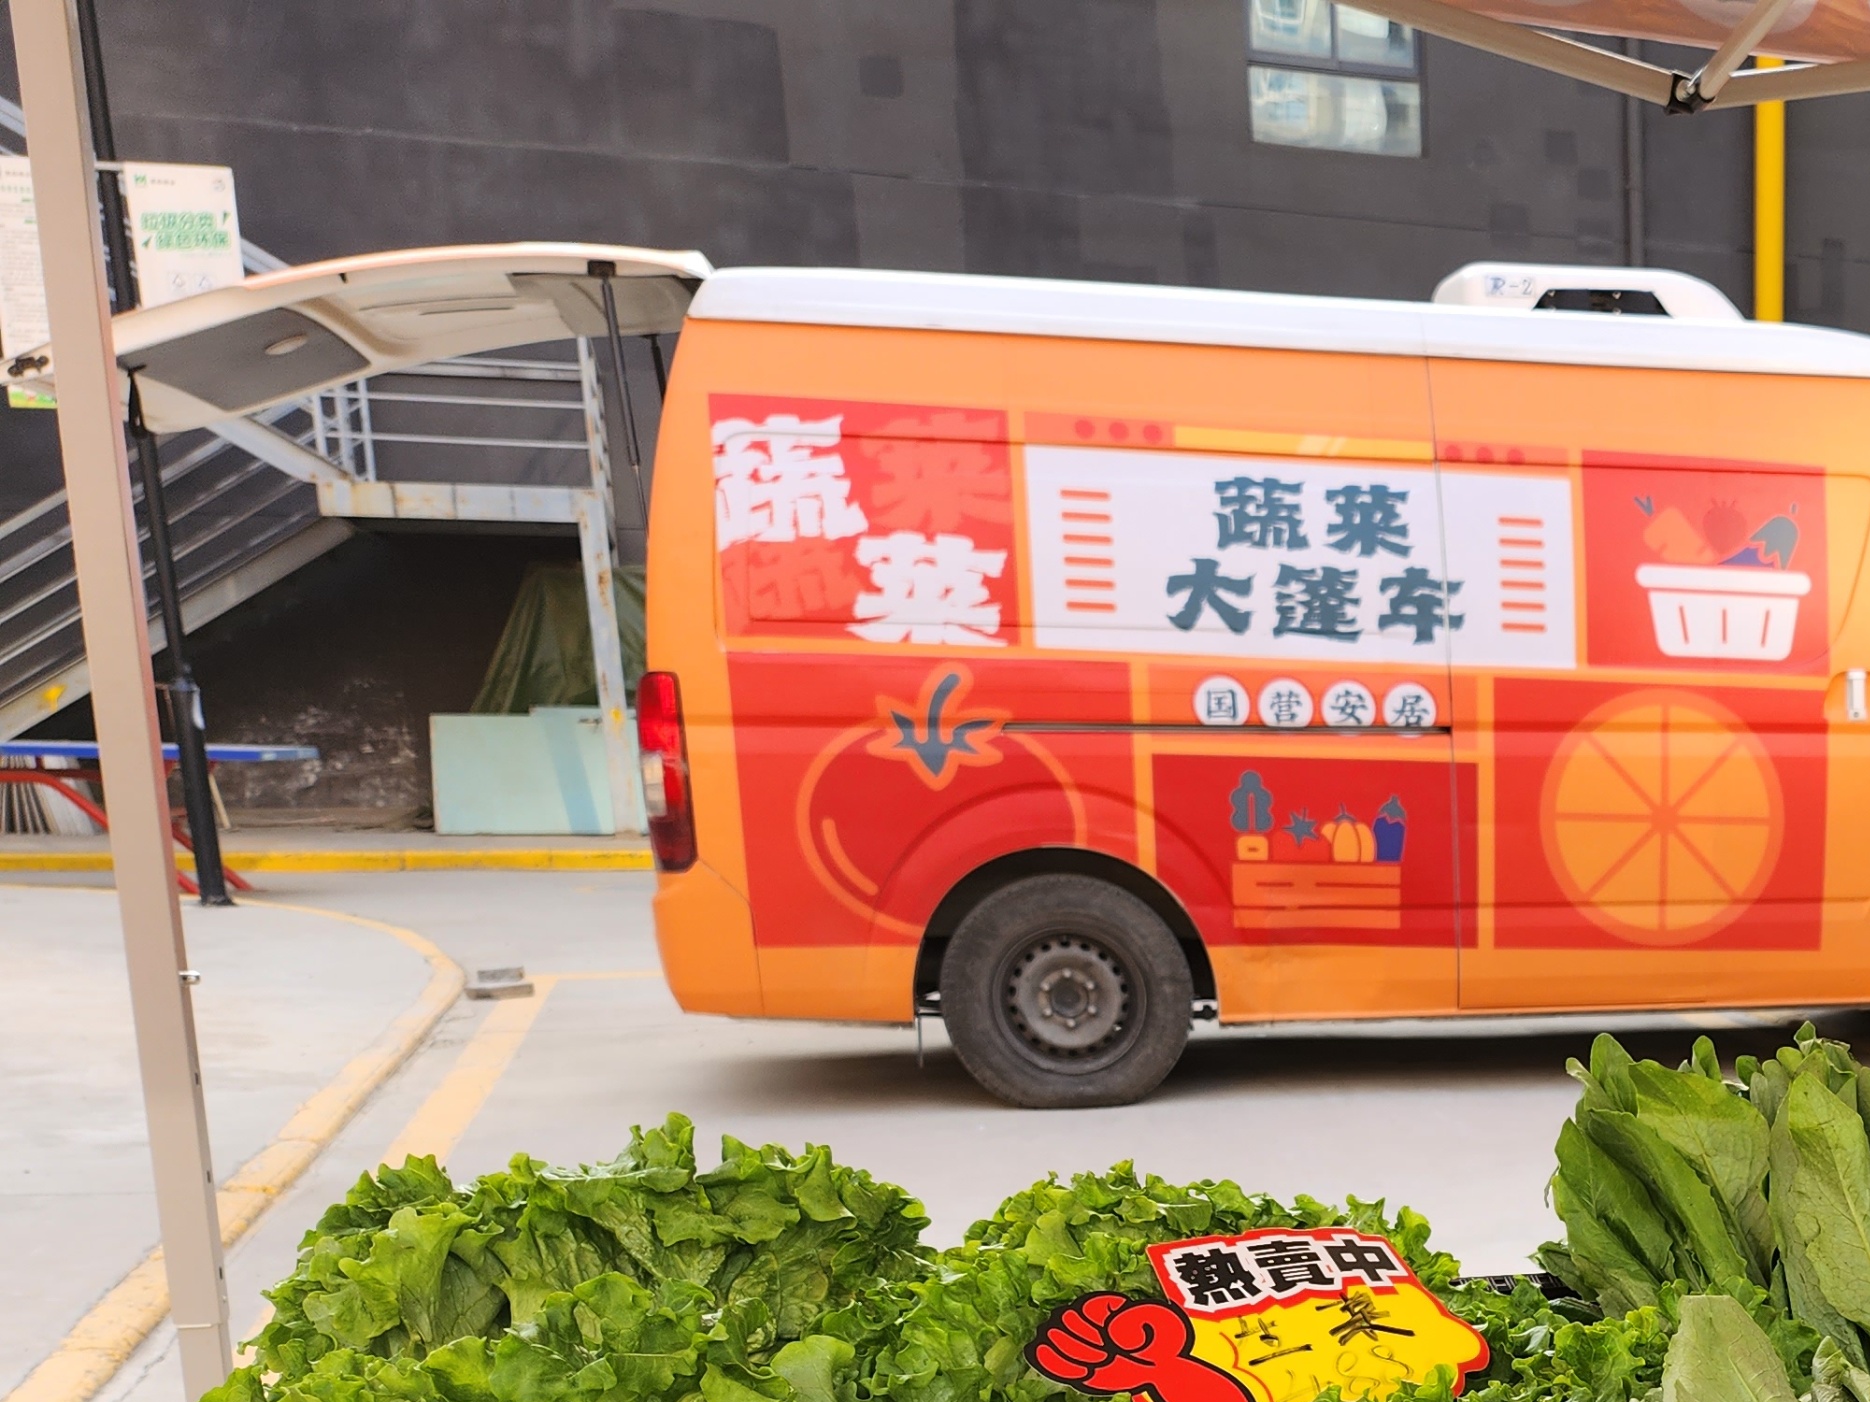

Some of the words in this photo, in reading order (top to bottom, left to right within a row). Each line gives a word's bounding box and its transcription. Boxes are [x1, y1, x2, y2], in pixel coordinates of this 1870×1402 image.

[1214, 475, 1415, 558] 蔬菜
[1165, 557, 1466, 647] 大篷车
[1203, 687, 1432, 731] 国营安居
[1172, 1238, 1400, 1306] 熱賣中
